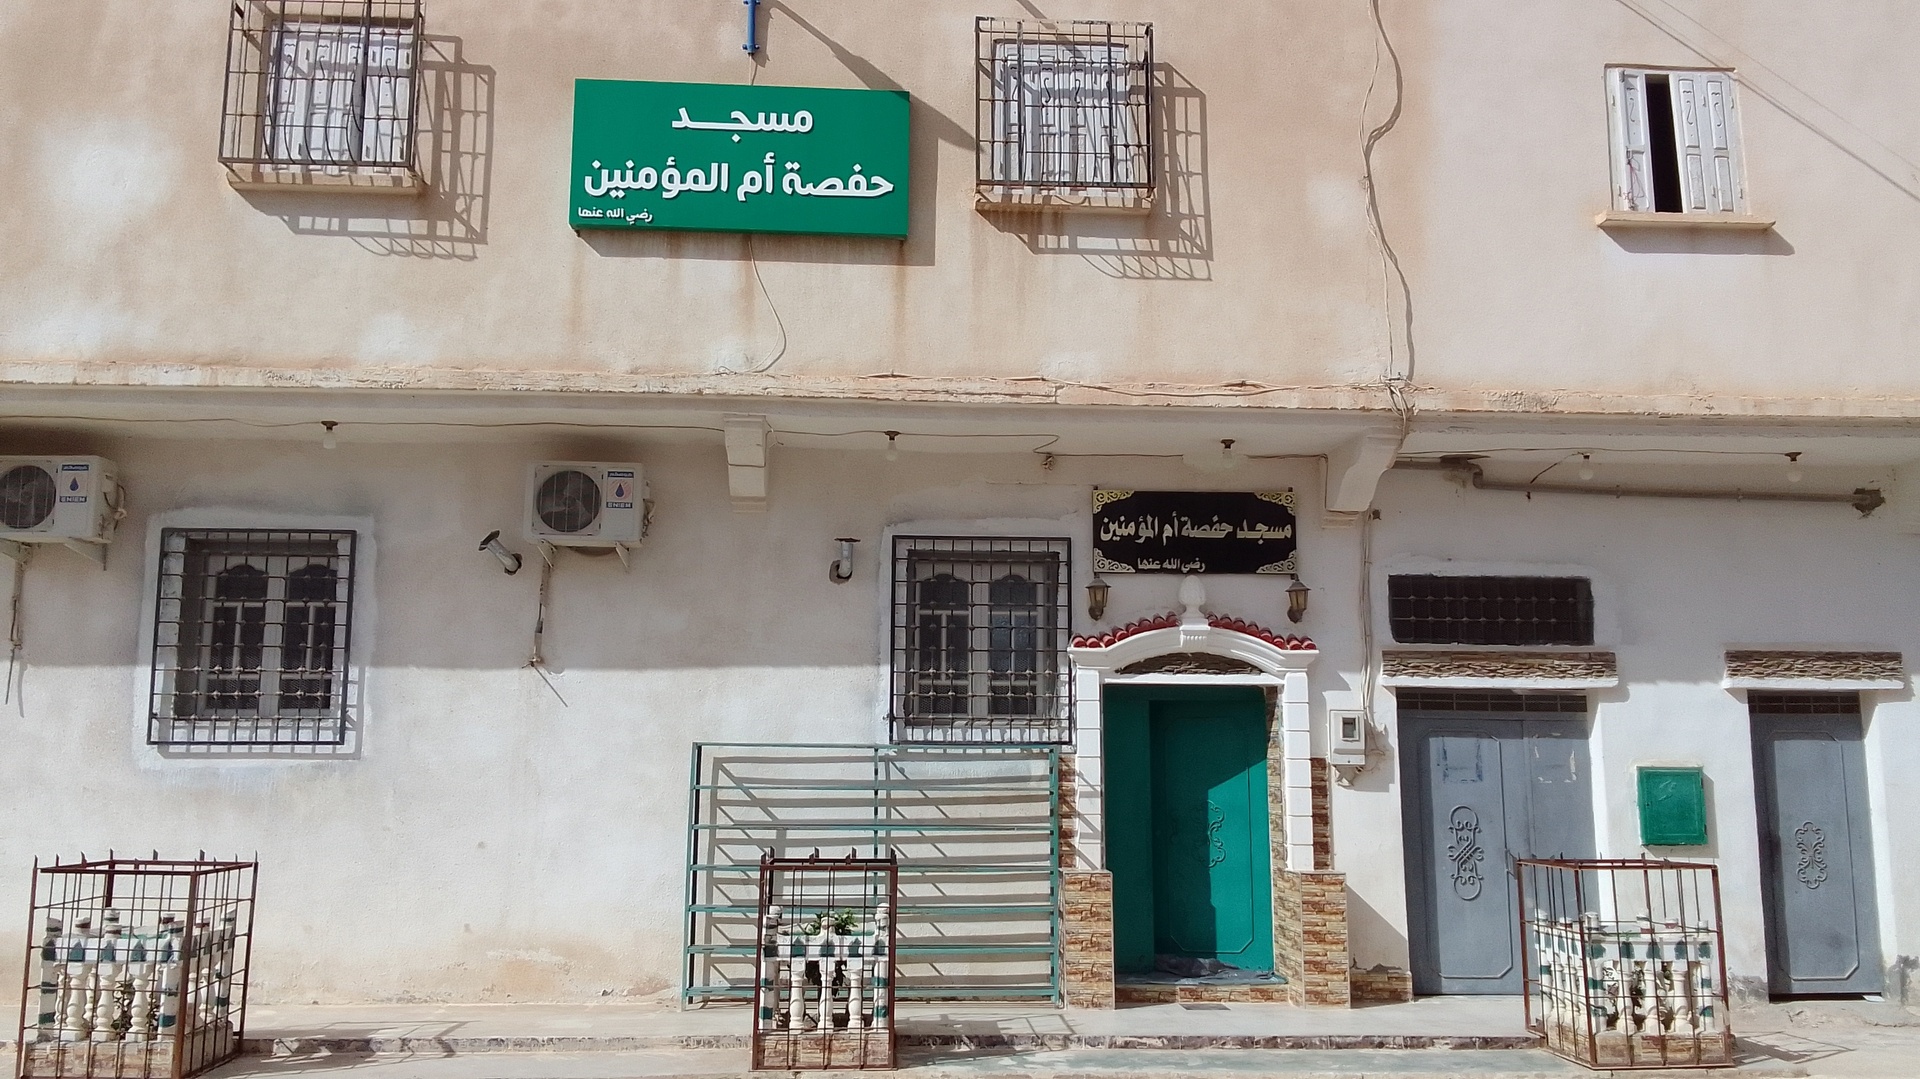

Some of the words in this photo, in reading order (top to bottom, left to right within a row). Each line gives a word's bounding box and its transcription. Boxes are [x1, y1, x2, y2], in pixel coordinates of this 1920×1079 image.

[671, 106, 814, 143] مسجد
[584, 156, 729, 200] المؤمنين
[737, 152, 776, 202] أم
[782, 161, 895, 198] حفصة
[578, 206, 604, 217] عنها
[606, 207, 624, 218] الله
[626, 208, 653, 225] رضي
[1100, 513, 1159, 544] المؤمنين
[1163, 511, 1178, 546] أم
[1180, 514, 1234, 539] حفصة
[1236, 519, 1292, 545] مسجد
[1137, 557, 1161, 570] عنها
[1163, 558, 1180, 570] الله
[1181, 557, 1206, 573] رضي
